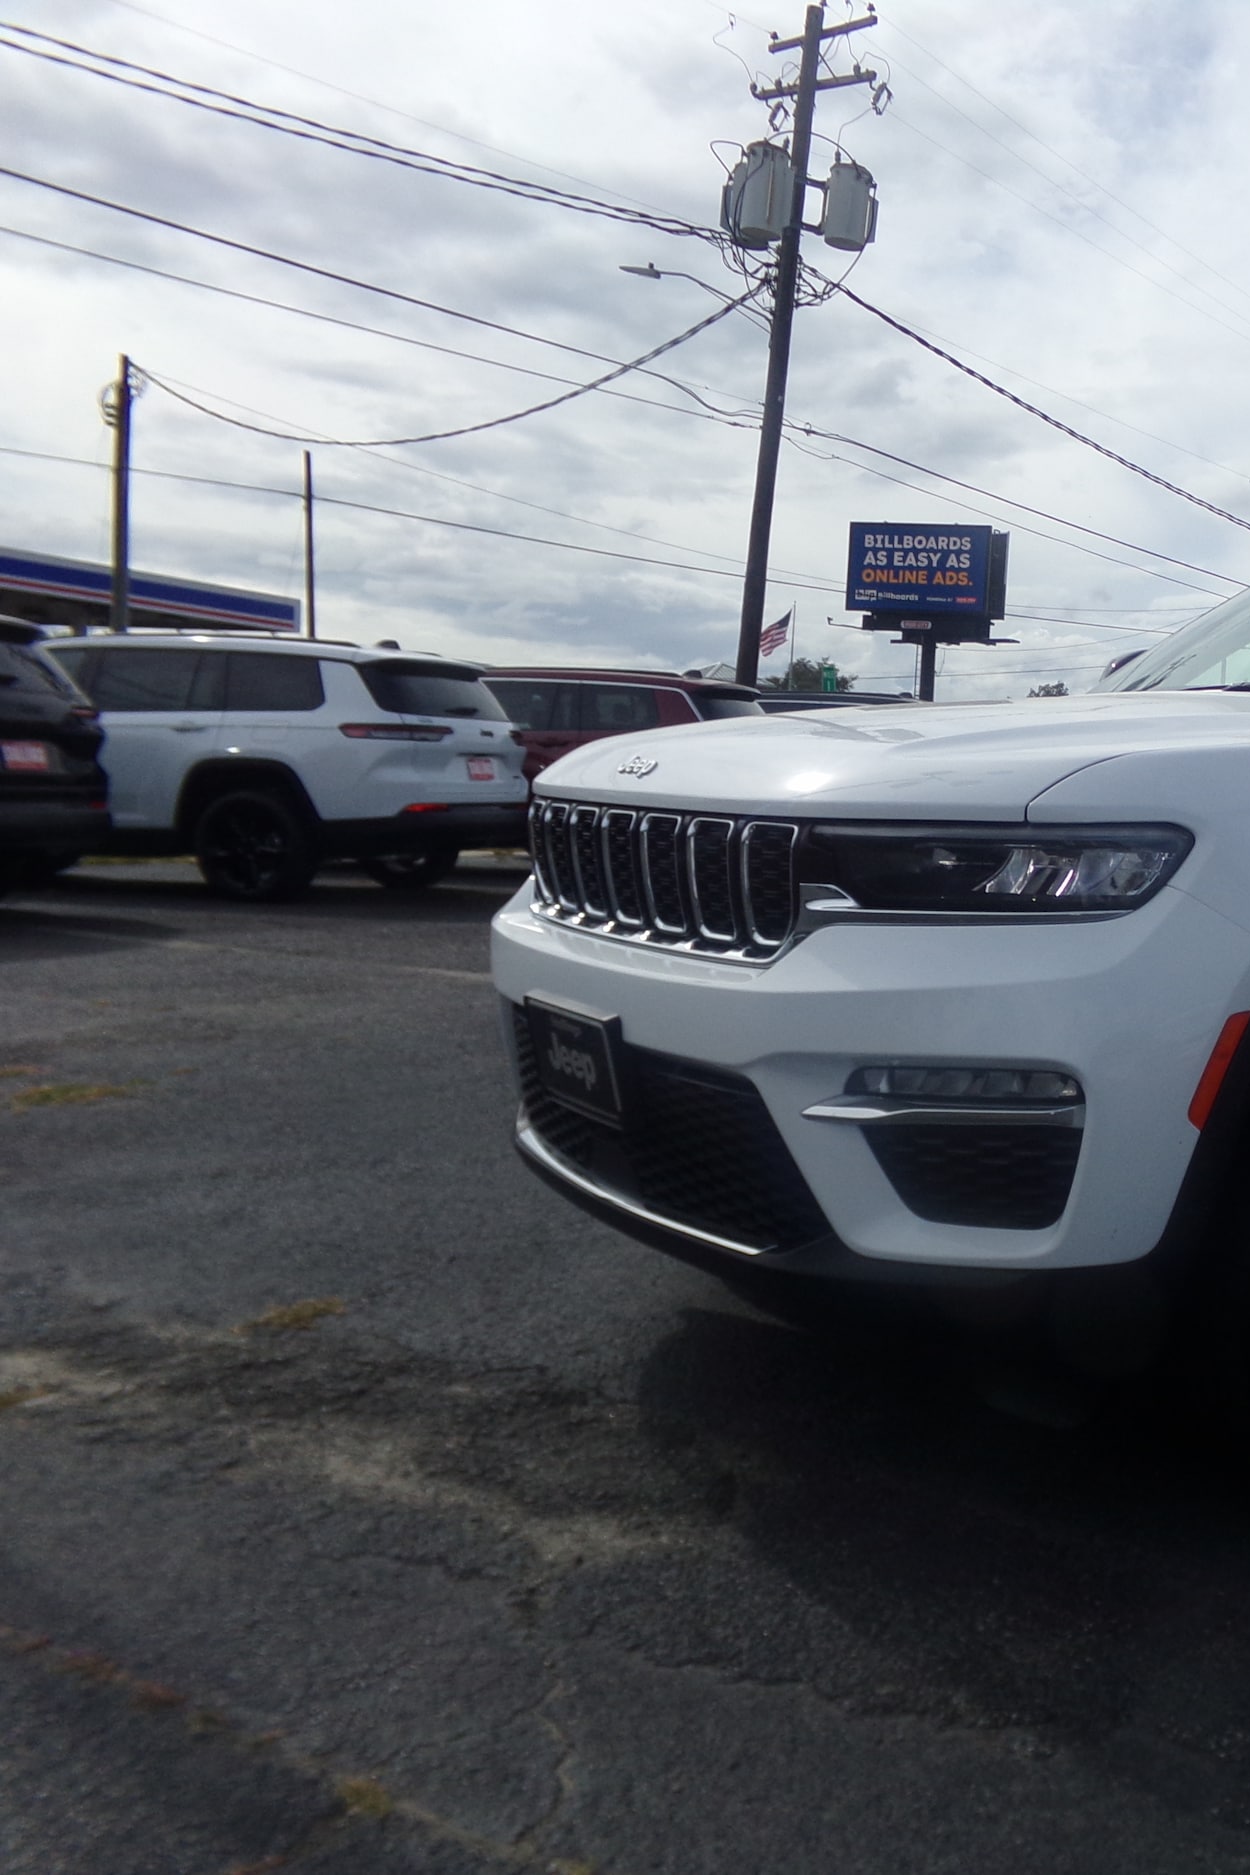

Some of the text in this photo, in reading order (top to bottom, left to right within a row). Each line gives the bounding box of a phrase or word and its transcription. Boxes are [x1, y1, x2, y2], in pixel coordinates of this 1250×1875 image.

[864, 534, 972, 550] BILLBOARDS
[864, 551, 970, 568] AS EASY AS
[862, 569, 973, 586] ONLINE ADS.
[617, 756, 658, 779] Jeep
[549, 1031, 597, 1091] Jeep
